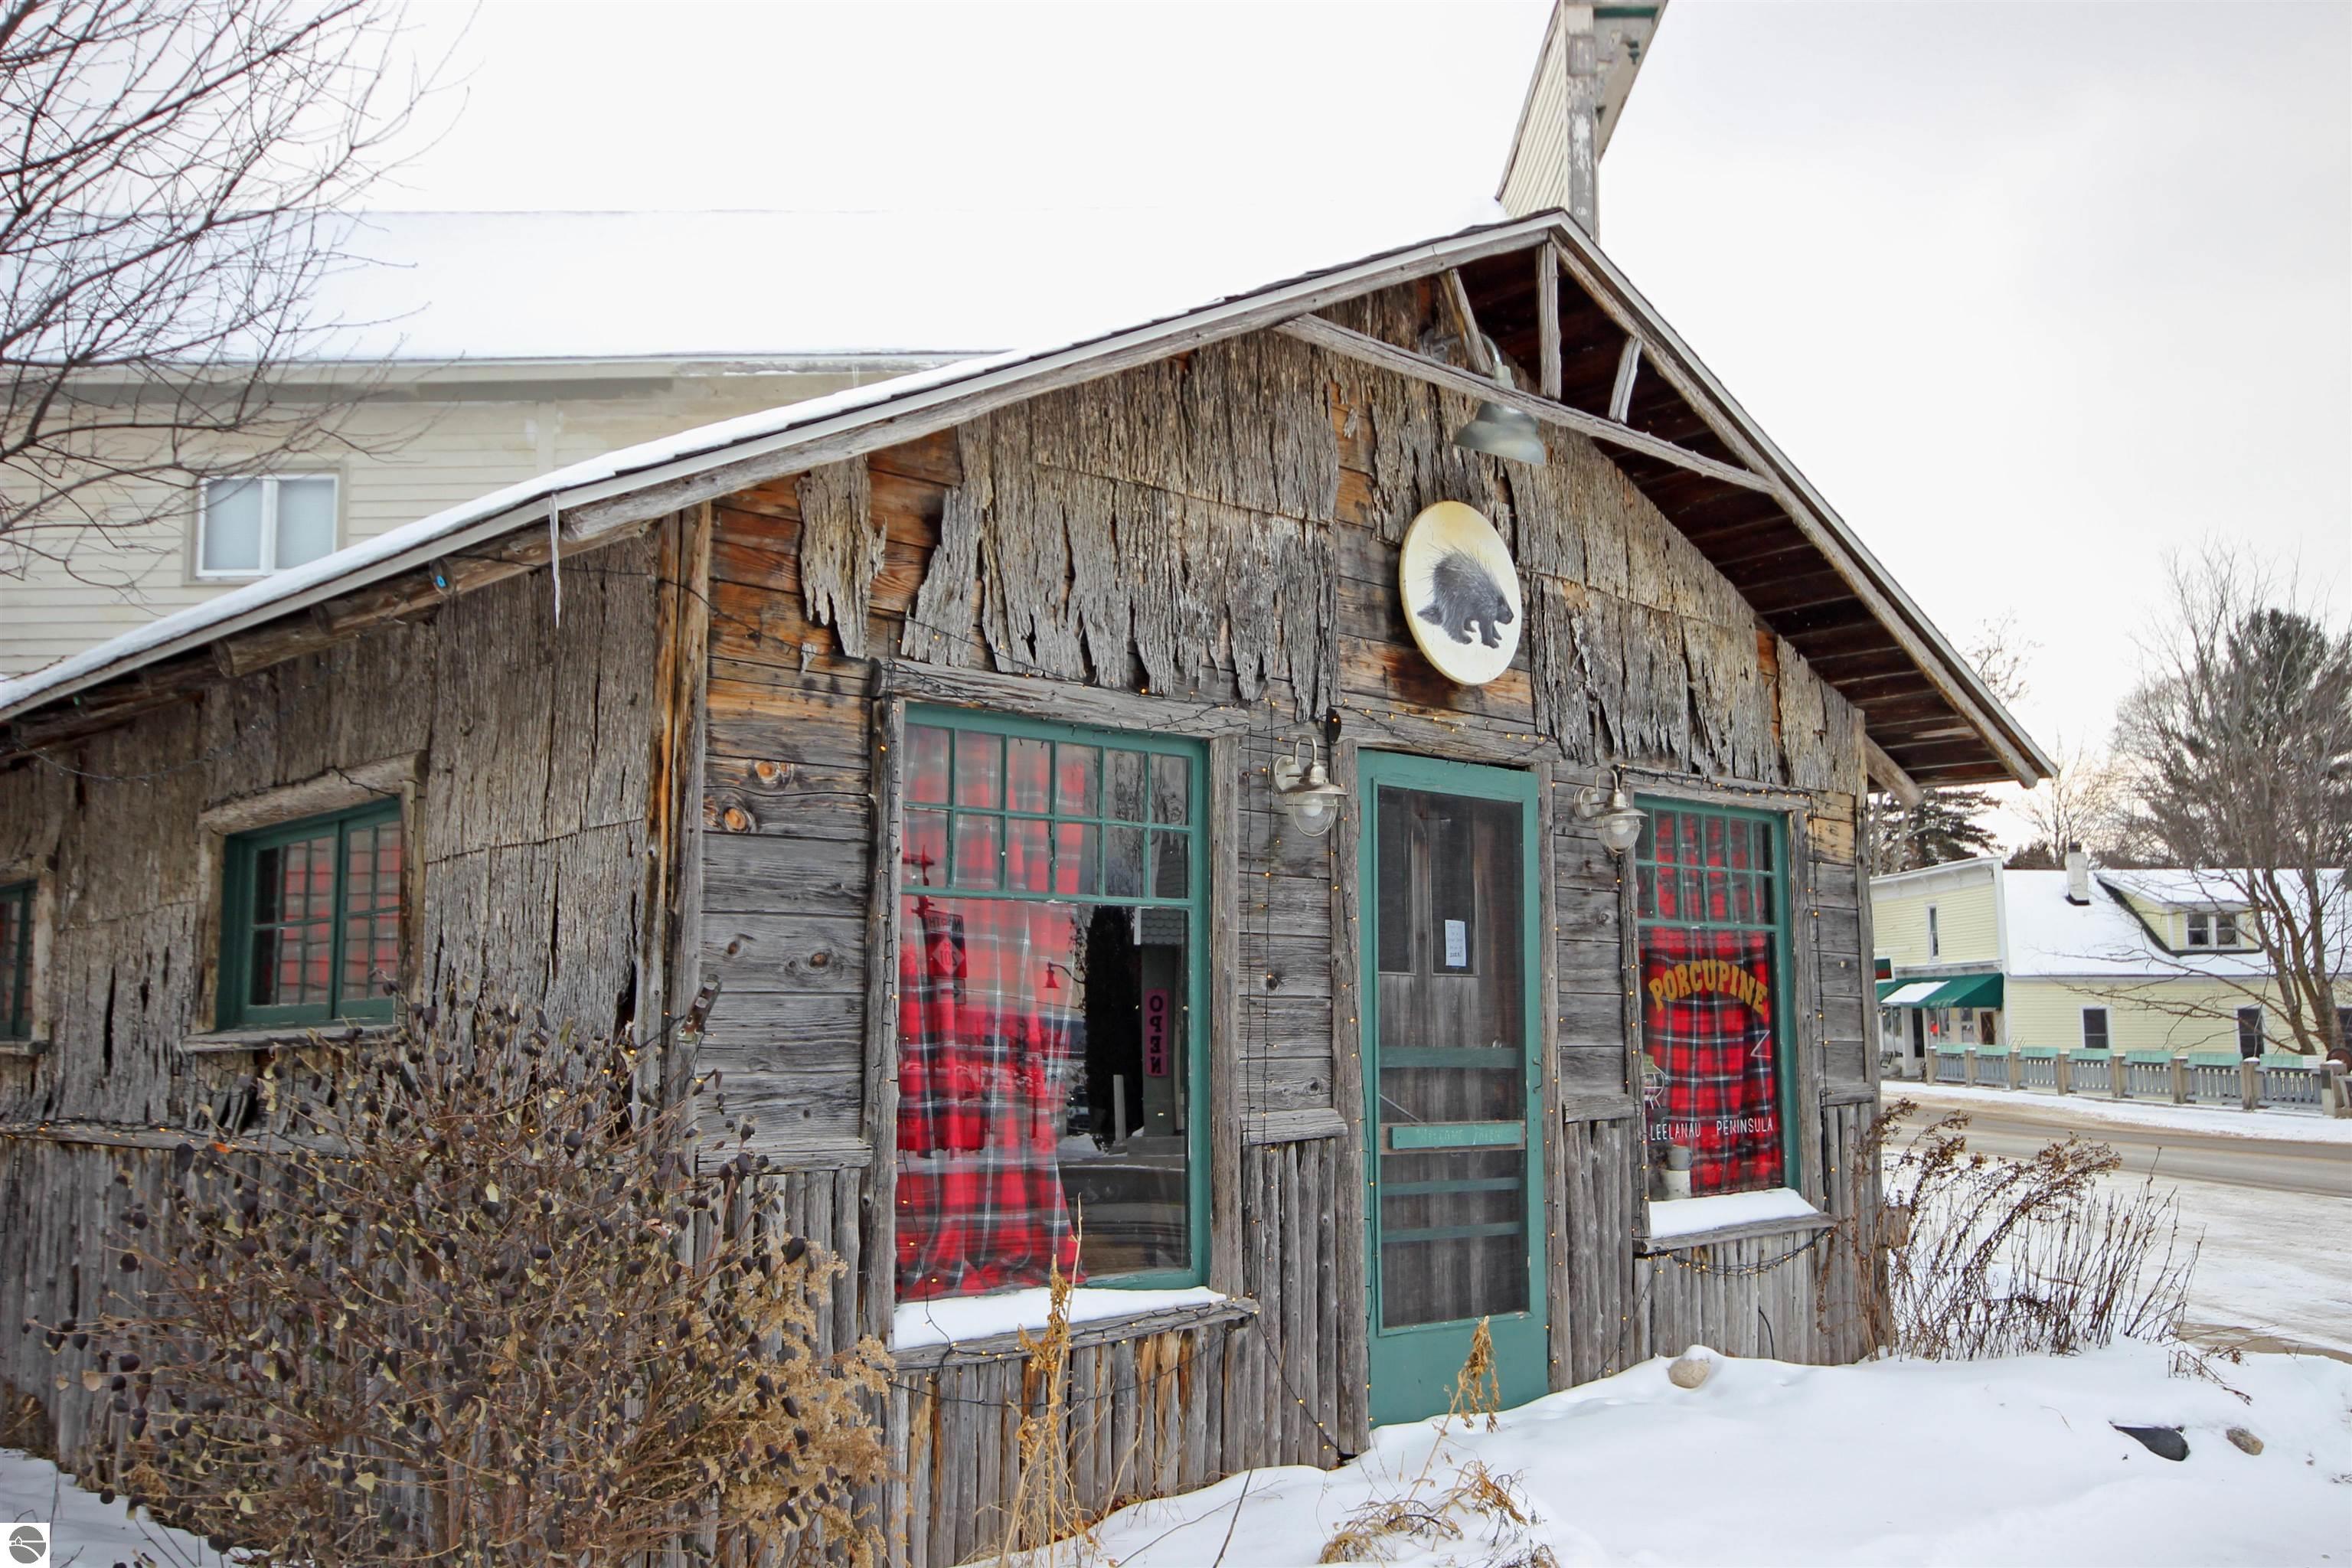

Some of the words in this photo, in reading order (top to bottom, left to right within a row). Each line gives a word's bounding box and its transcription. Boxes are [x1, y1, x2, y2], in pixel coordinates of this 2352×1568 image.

[1648, 959, 1769, 1014] PORCUPINE
[1650, 1122, 1701, 1141] LEELANAU
[1716, 1117, 1774, 1136] PENINSULA
